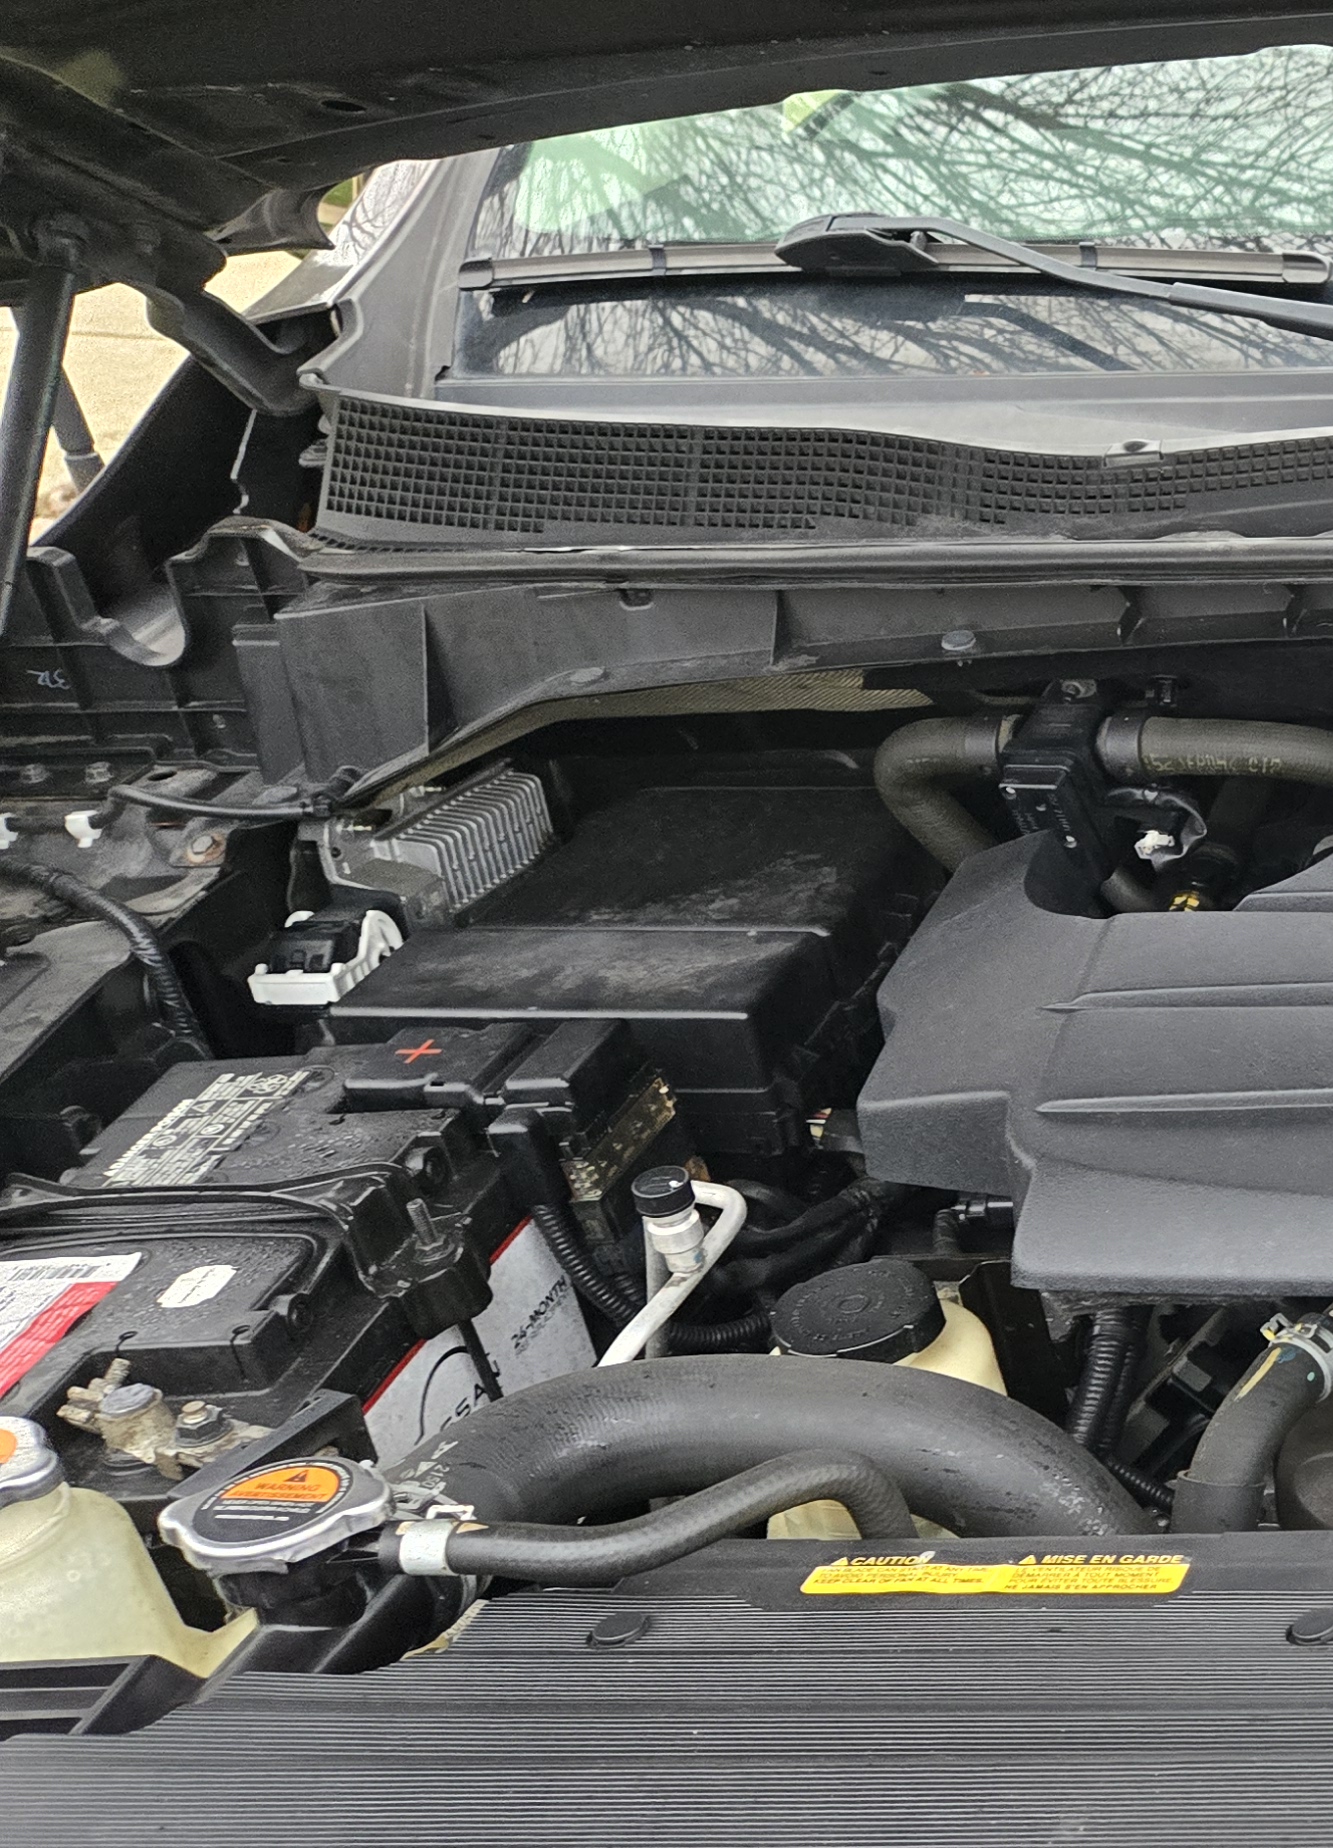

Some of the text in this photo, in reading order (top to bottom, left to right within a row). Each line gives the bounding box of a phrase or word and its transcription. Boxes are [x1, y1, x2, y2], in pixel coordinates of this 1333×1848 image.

[254, 1483, 322, 1492] WARNING
[850, 1555, 932, 1566] CAUTION
[1041, 1555, 1184, 1564] MISE EN GARDE
